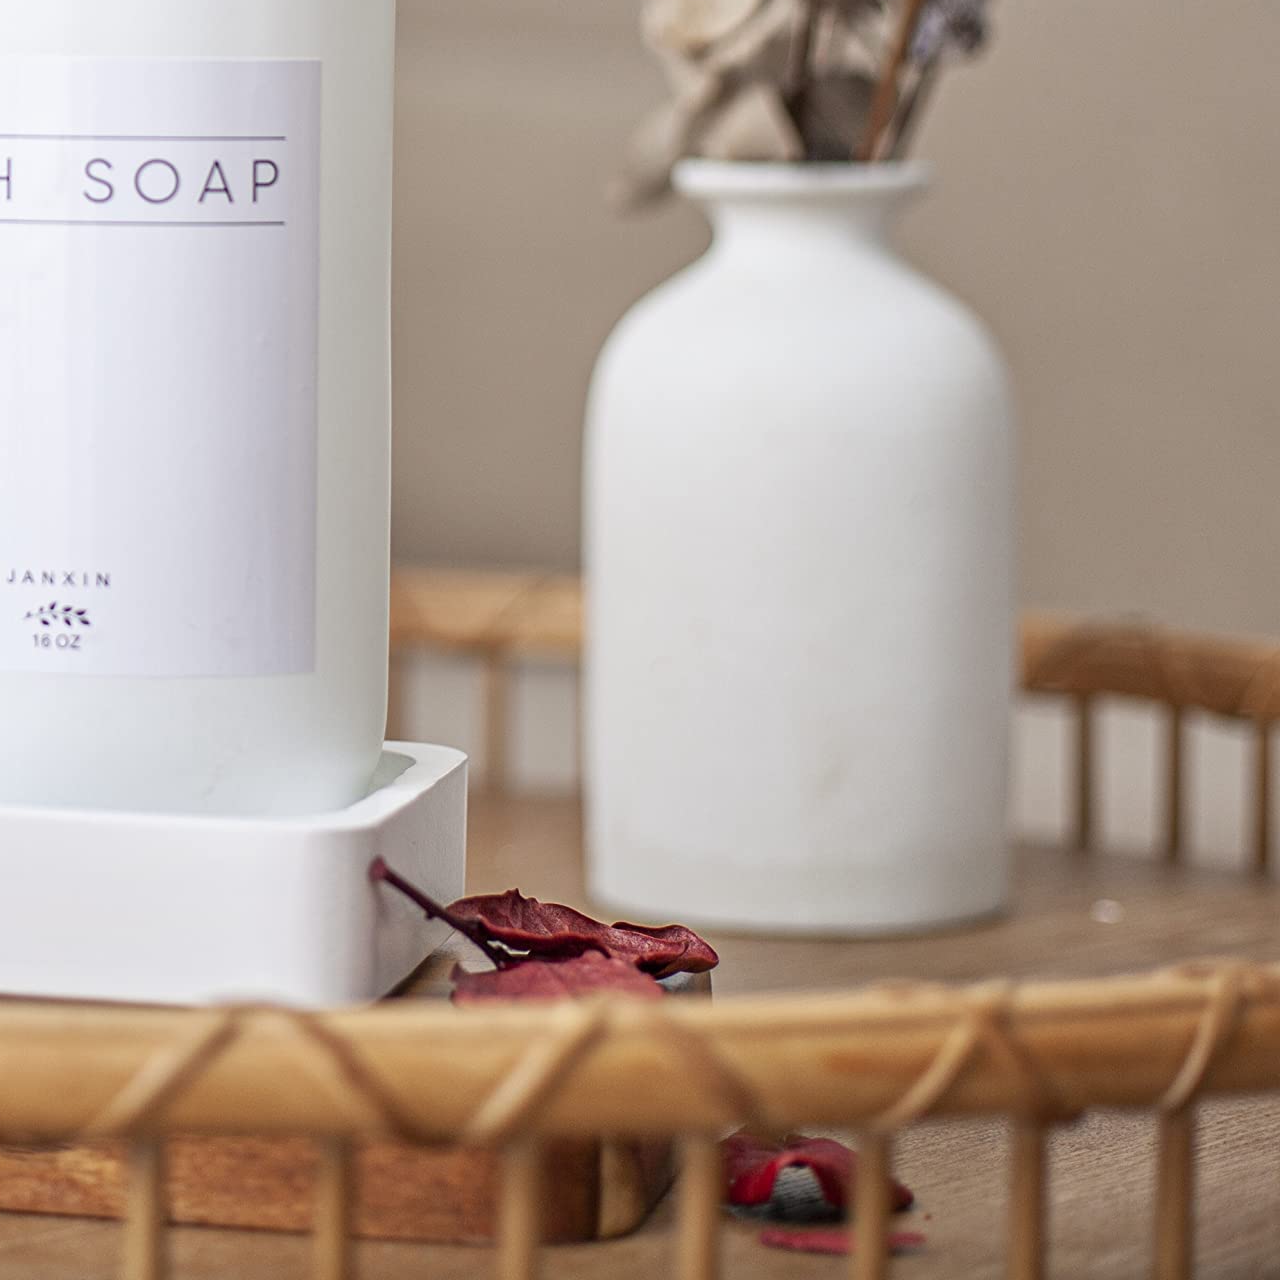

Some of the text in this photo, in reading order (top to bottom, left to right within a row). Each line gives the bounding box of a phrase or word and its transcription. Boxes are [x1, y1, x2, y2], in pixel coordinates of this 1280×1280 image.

[83, 157, 281, 205] SOAP
[7, 569, 111, 587] JANXIN
[33, 633, 81, 650] 16 OZ
